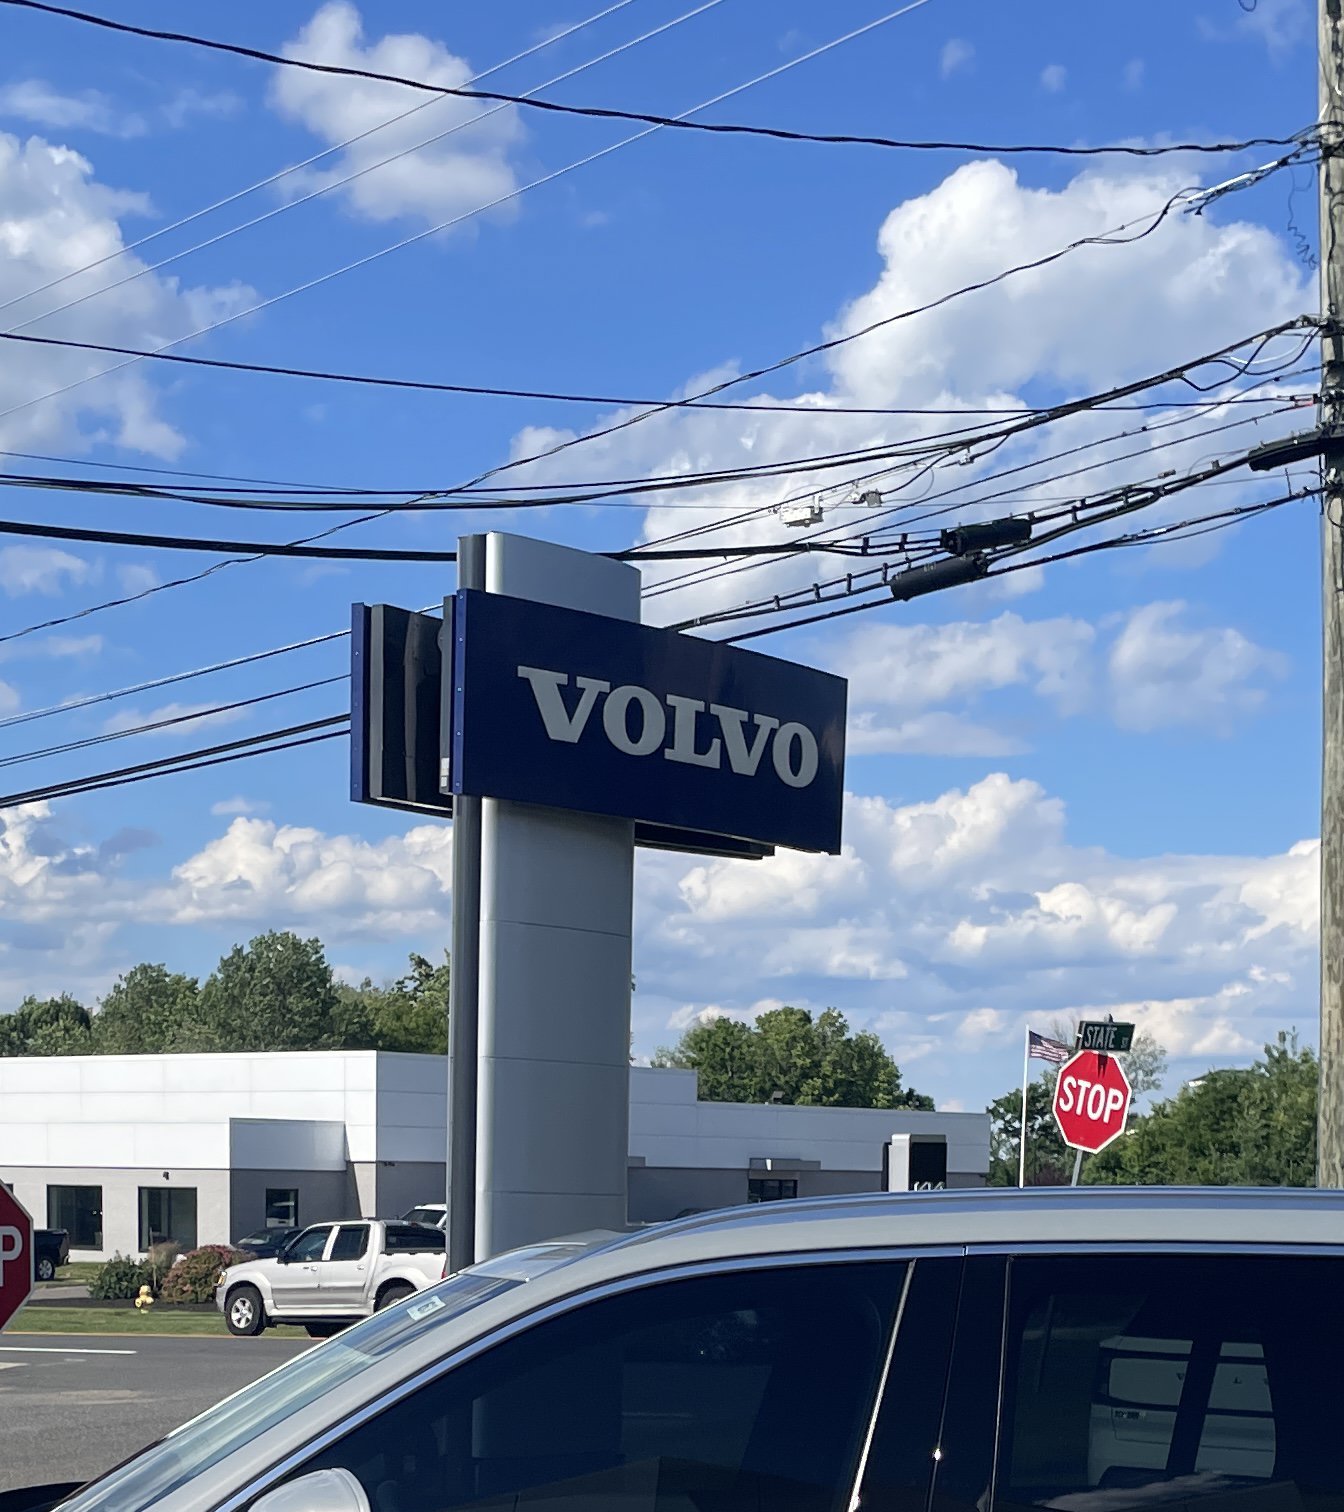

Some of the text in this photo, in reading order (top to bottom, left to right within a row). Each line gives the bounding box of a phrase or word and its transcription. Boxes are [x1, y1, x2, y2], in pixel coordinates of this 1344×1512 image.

[517, 665, 819, 788] VOLVO
[1084, 1025, 1117, 1049] STATE
[1059, 1075, 1124, 1124] STOP
